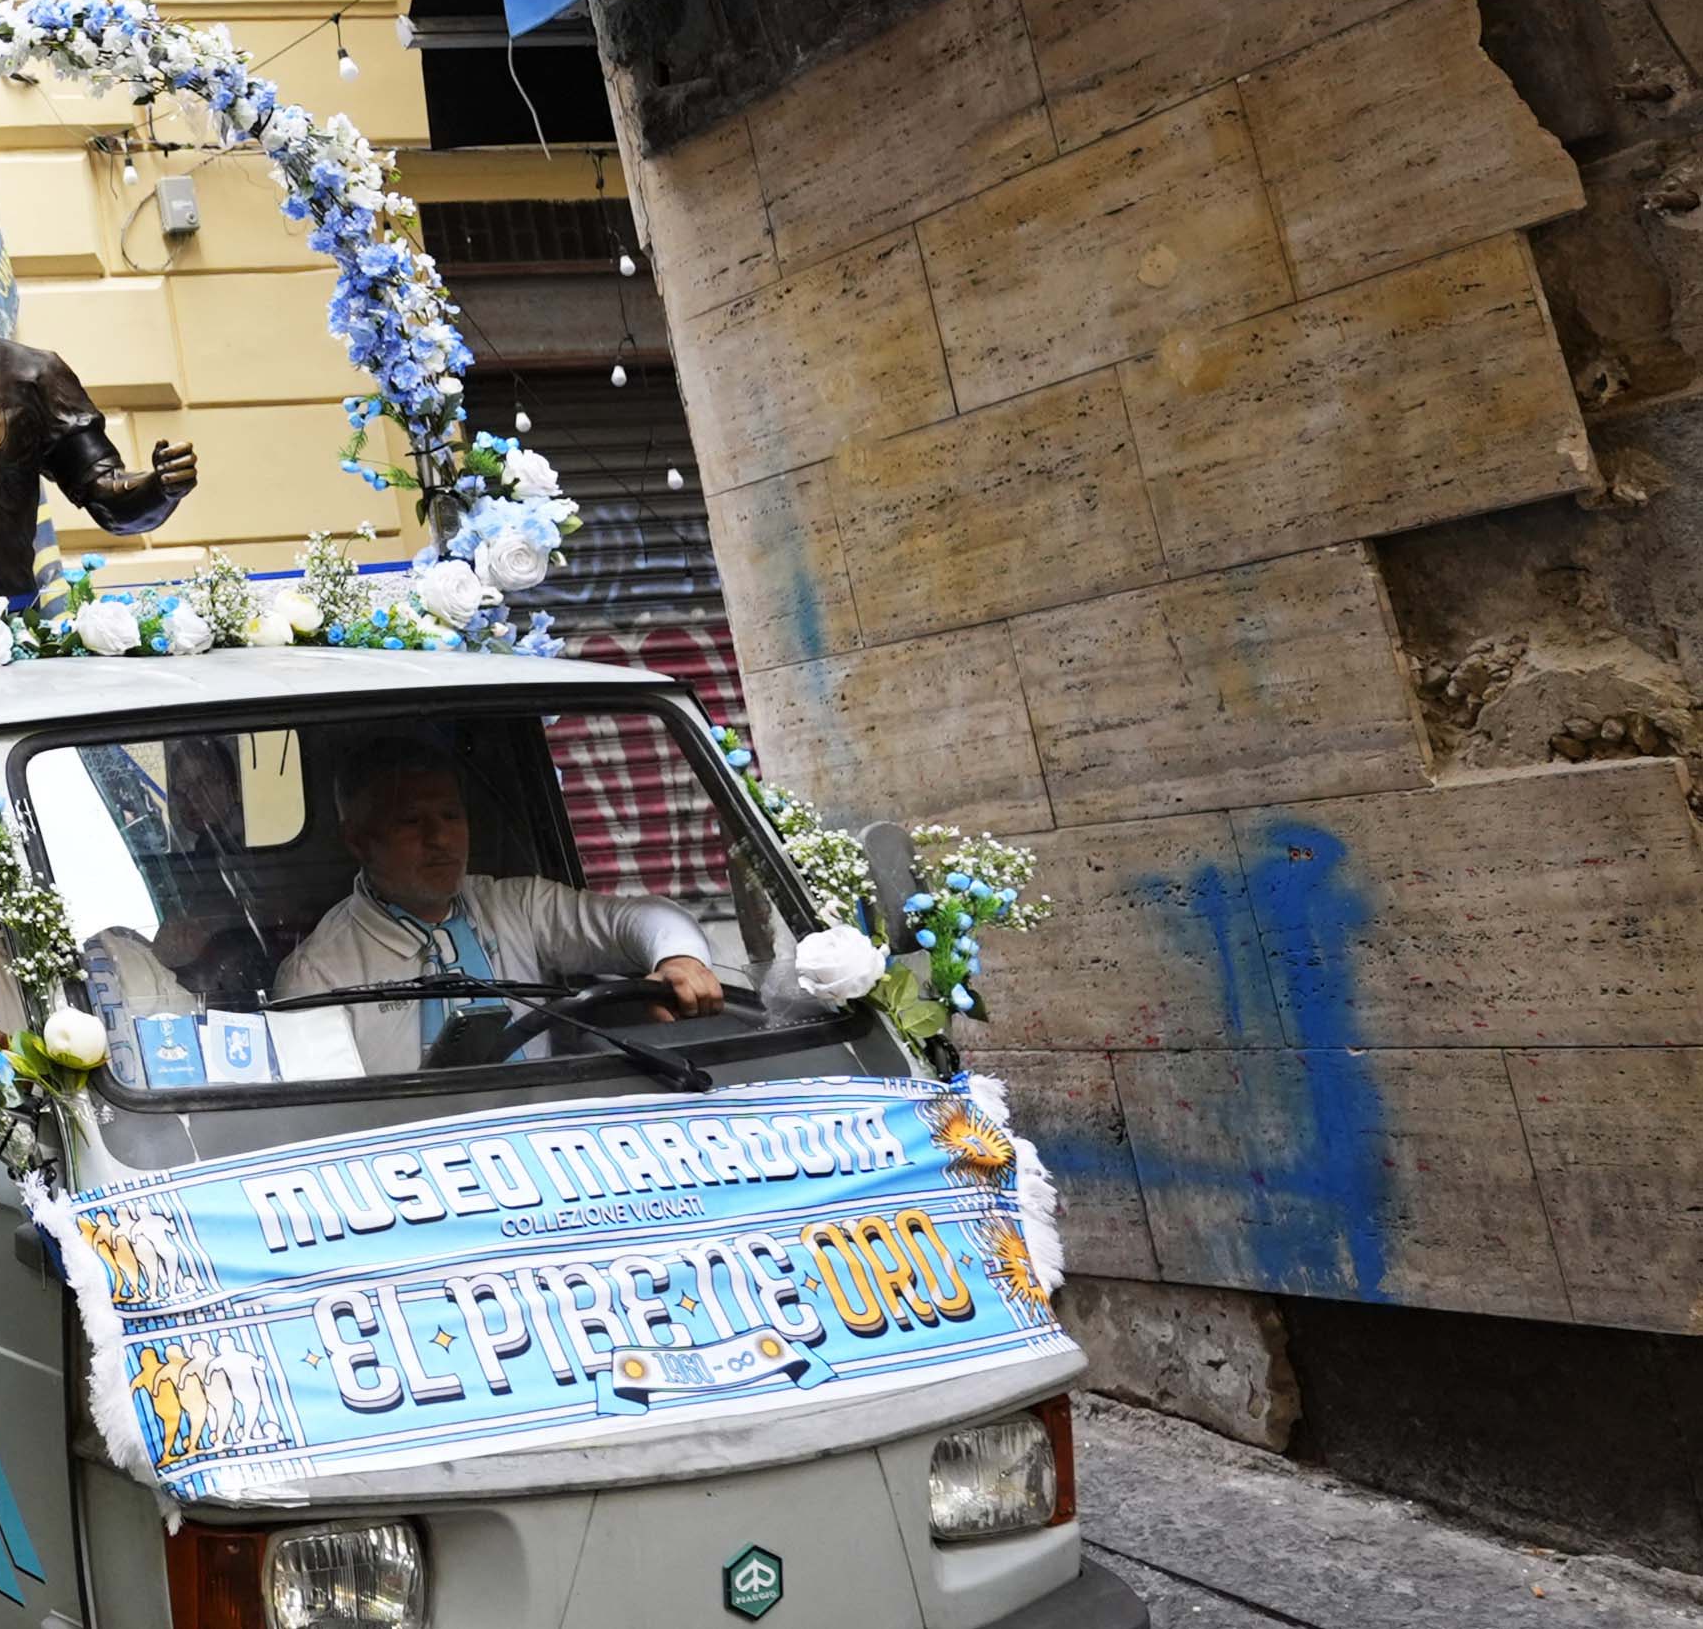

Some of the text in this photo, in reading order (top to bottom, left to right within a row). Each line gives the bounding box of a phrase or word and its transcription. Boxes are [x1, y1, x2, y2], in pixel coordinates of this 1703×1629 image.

[241, 1107, 915, 1253] MUSEO MARADONA
[501, 1196, 705, 1238] COLLEZIONE VIGNATI
[313, 1283, 468, 1413] EL
[800, 1209, 976, 1338] ORO
[650, 1350, 716, 1385] 1960
